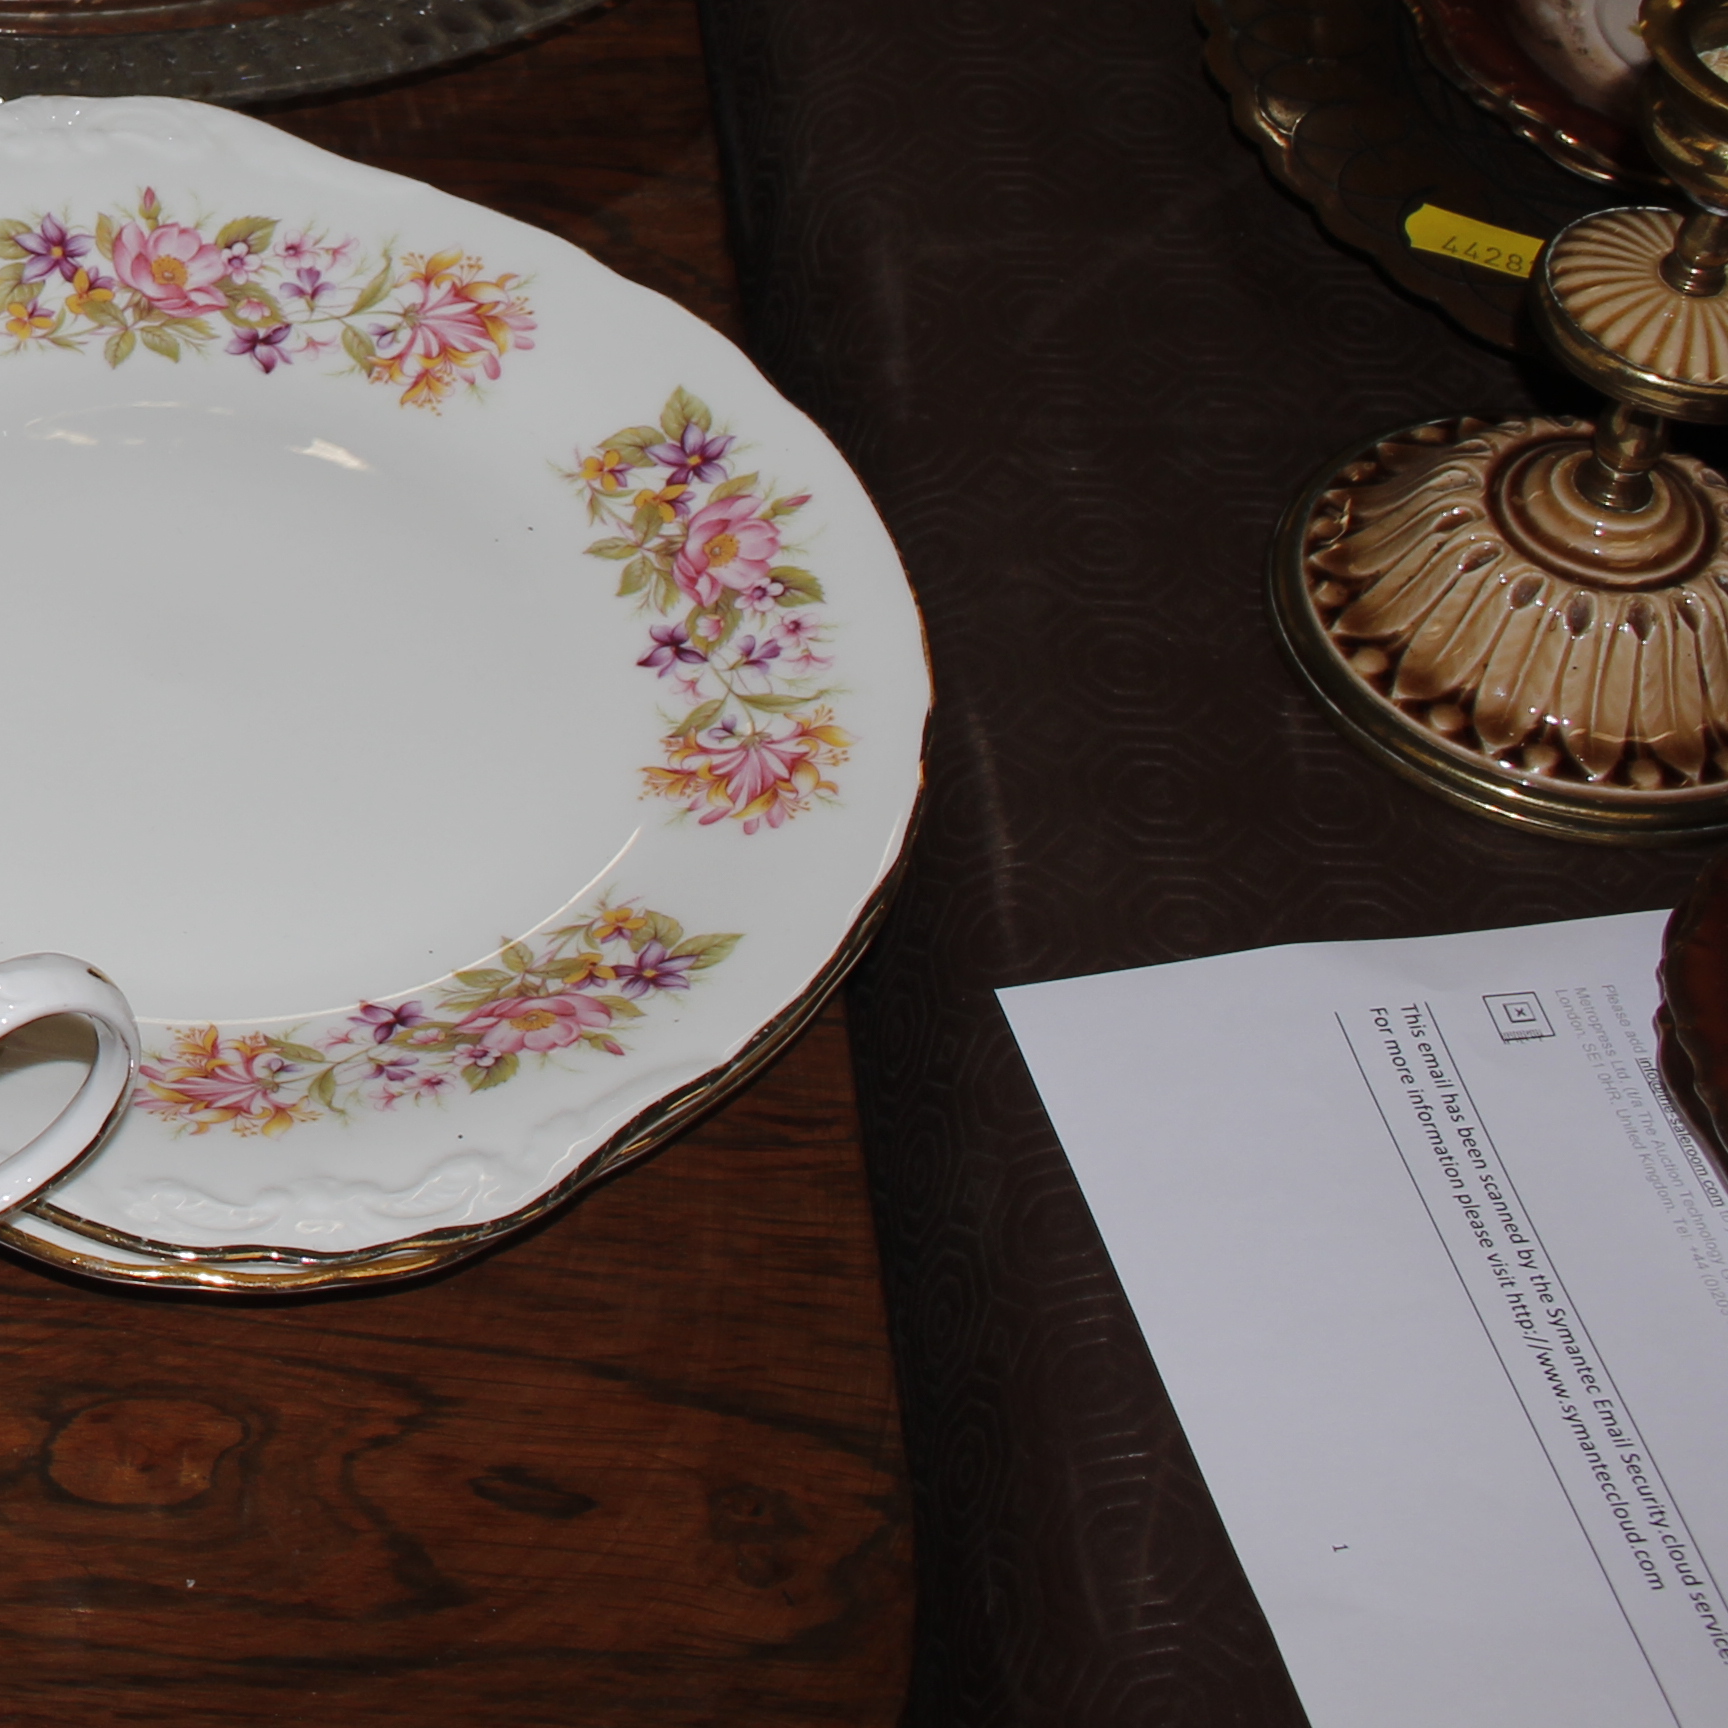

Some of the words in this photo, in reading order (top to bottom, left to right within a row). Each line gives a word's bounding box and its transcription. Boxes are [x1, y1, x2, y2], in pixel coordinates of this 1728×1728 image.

[1441, 236, 1536, 273] 4428
[1574, 986, 1618, 1058] Metropress
[1610, 1059, 1632, 1084] Ltd.
[1638, 1110, 1658, 1137] The
[1650, 1139, 1685, 1188] Auction
[1679, 1190, 1726, 1265] Technology
[1601, 983, 1631, 1028] Please
[1624, 1029, 1649, 1054] add
[1581, 1042, 1606, 1069] SE1
[1615, 1108, 1648, 1151] United
[1689, 1244, 1710, 1270] +44
[1369, 1006, 1395, 1036] For
[1383, 1038, 1415, 1086] more
[1406, 1088, 1466, 1190] information
[1452, 1193, 1495, 1250] please
[1486, 1251, 1517, 1289] visit
[1505, 1291, 1666, 1592] http://www.symanteccloud.com
[1400, 1002, 1427, 1039] This
[1417, 1042, 1455, 1089] email
[1440, 1092, 1466, 1123] has
[1456, 1126, 1488, 1170] been
[1478, 1173, 1531, 1245] scanned
[1516, 1248, 1538, 1271] by
[1529, 1274, 1555, 1304] the
[1546, 1307, 1602, 1395] Symantec
[1592, 1398, 1636, 1449] Email
[1619, 1452, 1705, 1588] Security.cloud
[1330, 1543, 1350, 1553] 1
